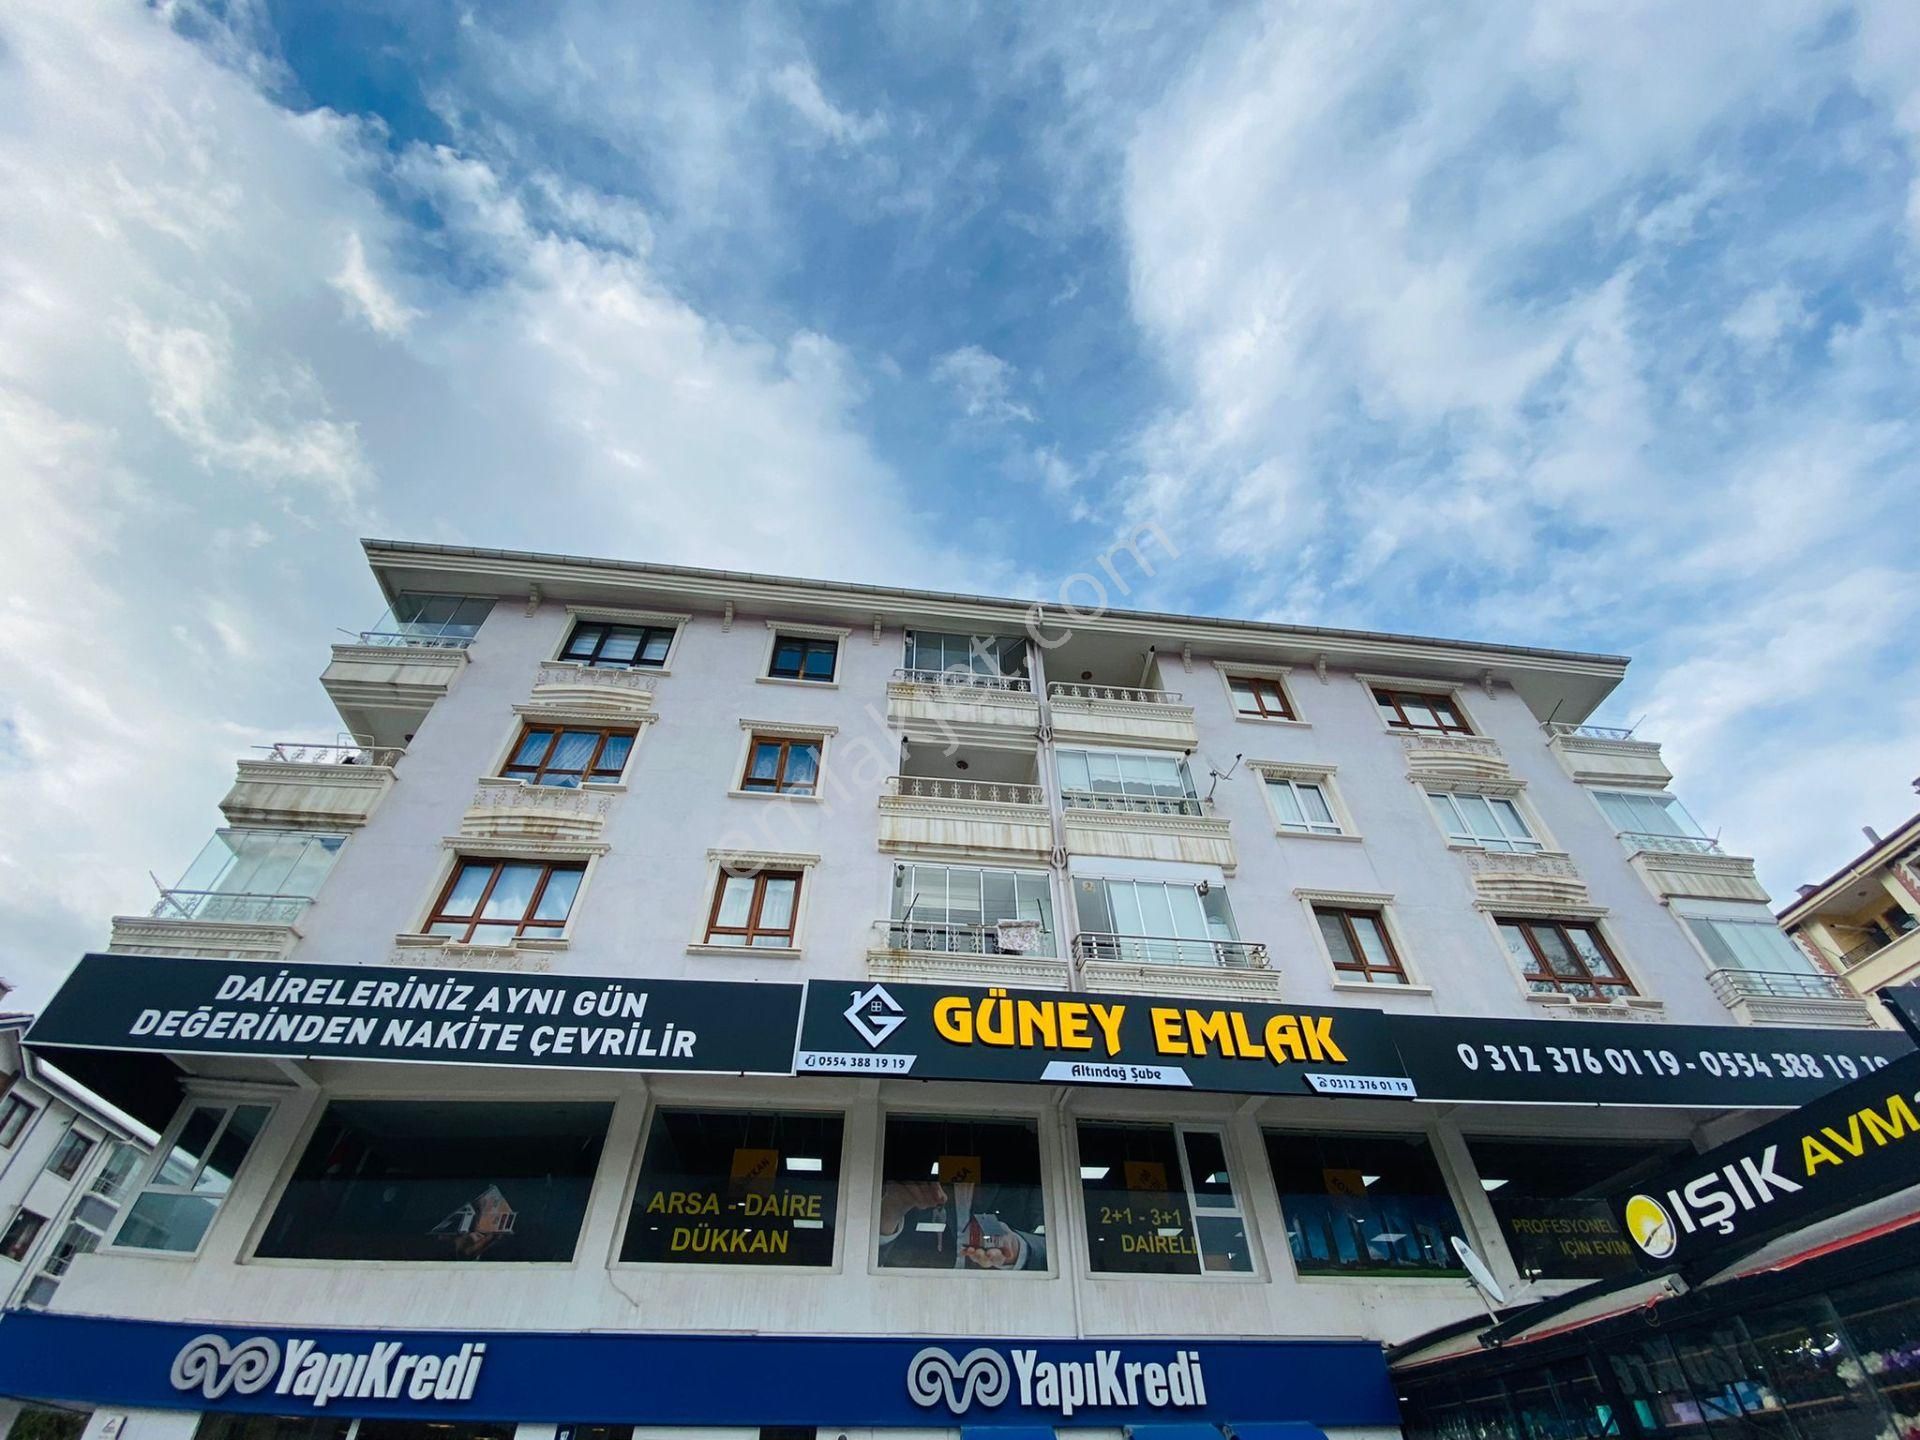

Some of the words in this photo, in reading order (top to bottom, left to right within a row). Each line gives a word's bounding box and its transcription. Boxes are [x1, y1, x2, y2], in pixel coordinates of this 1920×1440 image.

[215, 970, 475, 1011] DAİRELERİNİZ
[474, 986, 566, 1015] AYNI
[572, 984, 648, 1018] GÜN
[129, 1006, 378, 1045] DEĞERİNDEN
[380, 1015, 524, 1051] NAKİTE
[529, 1022, 697, 1057] ÇEVRİLİR
[933, 988, 1125, 1056] GÜNEY
[1150, 1007, 1348, 1065] EMLAK
[818, 1056, 847, 1067] 0554
[850, 1057, 871, 1067] 388
[875, 1058, 888, 1068] 19
[893, 1059, 906, 1069] 19
[1071, 1064, 1127, 1080] Altındağ
[1131, 1067, 1162, 1082] Şube
[1457, 1043, 1479, 1071] 0
[1483, 1045, 1541, 1072] 312
[1545, 1047, 1603, 1074] 376
[1604, 1048, 1643, 1075] 01
[1643, 1049, 1680, 1076] 19
[1699, 1051, 1773, 1078] 0554
[1771, 1053, 1824, 1078] 388
[1823, 1054, 1858, 1079] 19
[1329, 1079, 1356, 1089] 0312
[1359, 1080, 1378, 1090] 376
[1380, 1081, 1393, 1091] 01
[1396, 1081, 1408, 1091] 19
[1667, 1144, 1803, 1235] IŞIK
[1801, 1094, 1920, 1176] AVM
[647, 1190, 720, 1215] ARSA
[744, 1189, 822, 1218] DAİRE
[1101, 1206, 1133, 1225] 2+1
[1151, 1207, 1182, 1226] 3+1
[670, 1222, 789, 1254] DÜKKAN
[1511, 1218, 1619, 1234] PROFESYONEL
[1559, 1237, 1593, 1259] İÇİN
[274, 1338, 487, 1407] YapıKredi
[1011, 1350, 1207, 1415] YapıKredi
